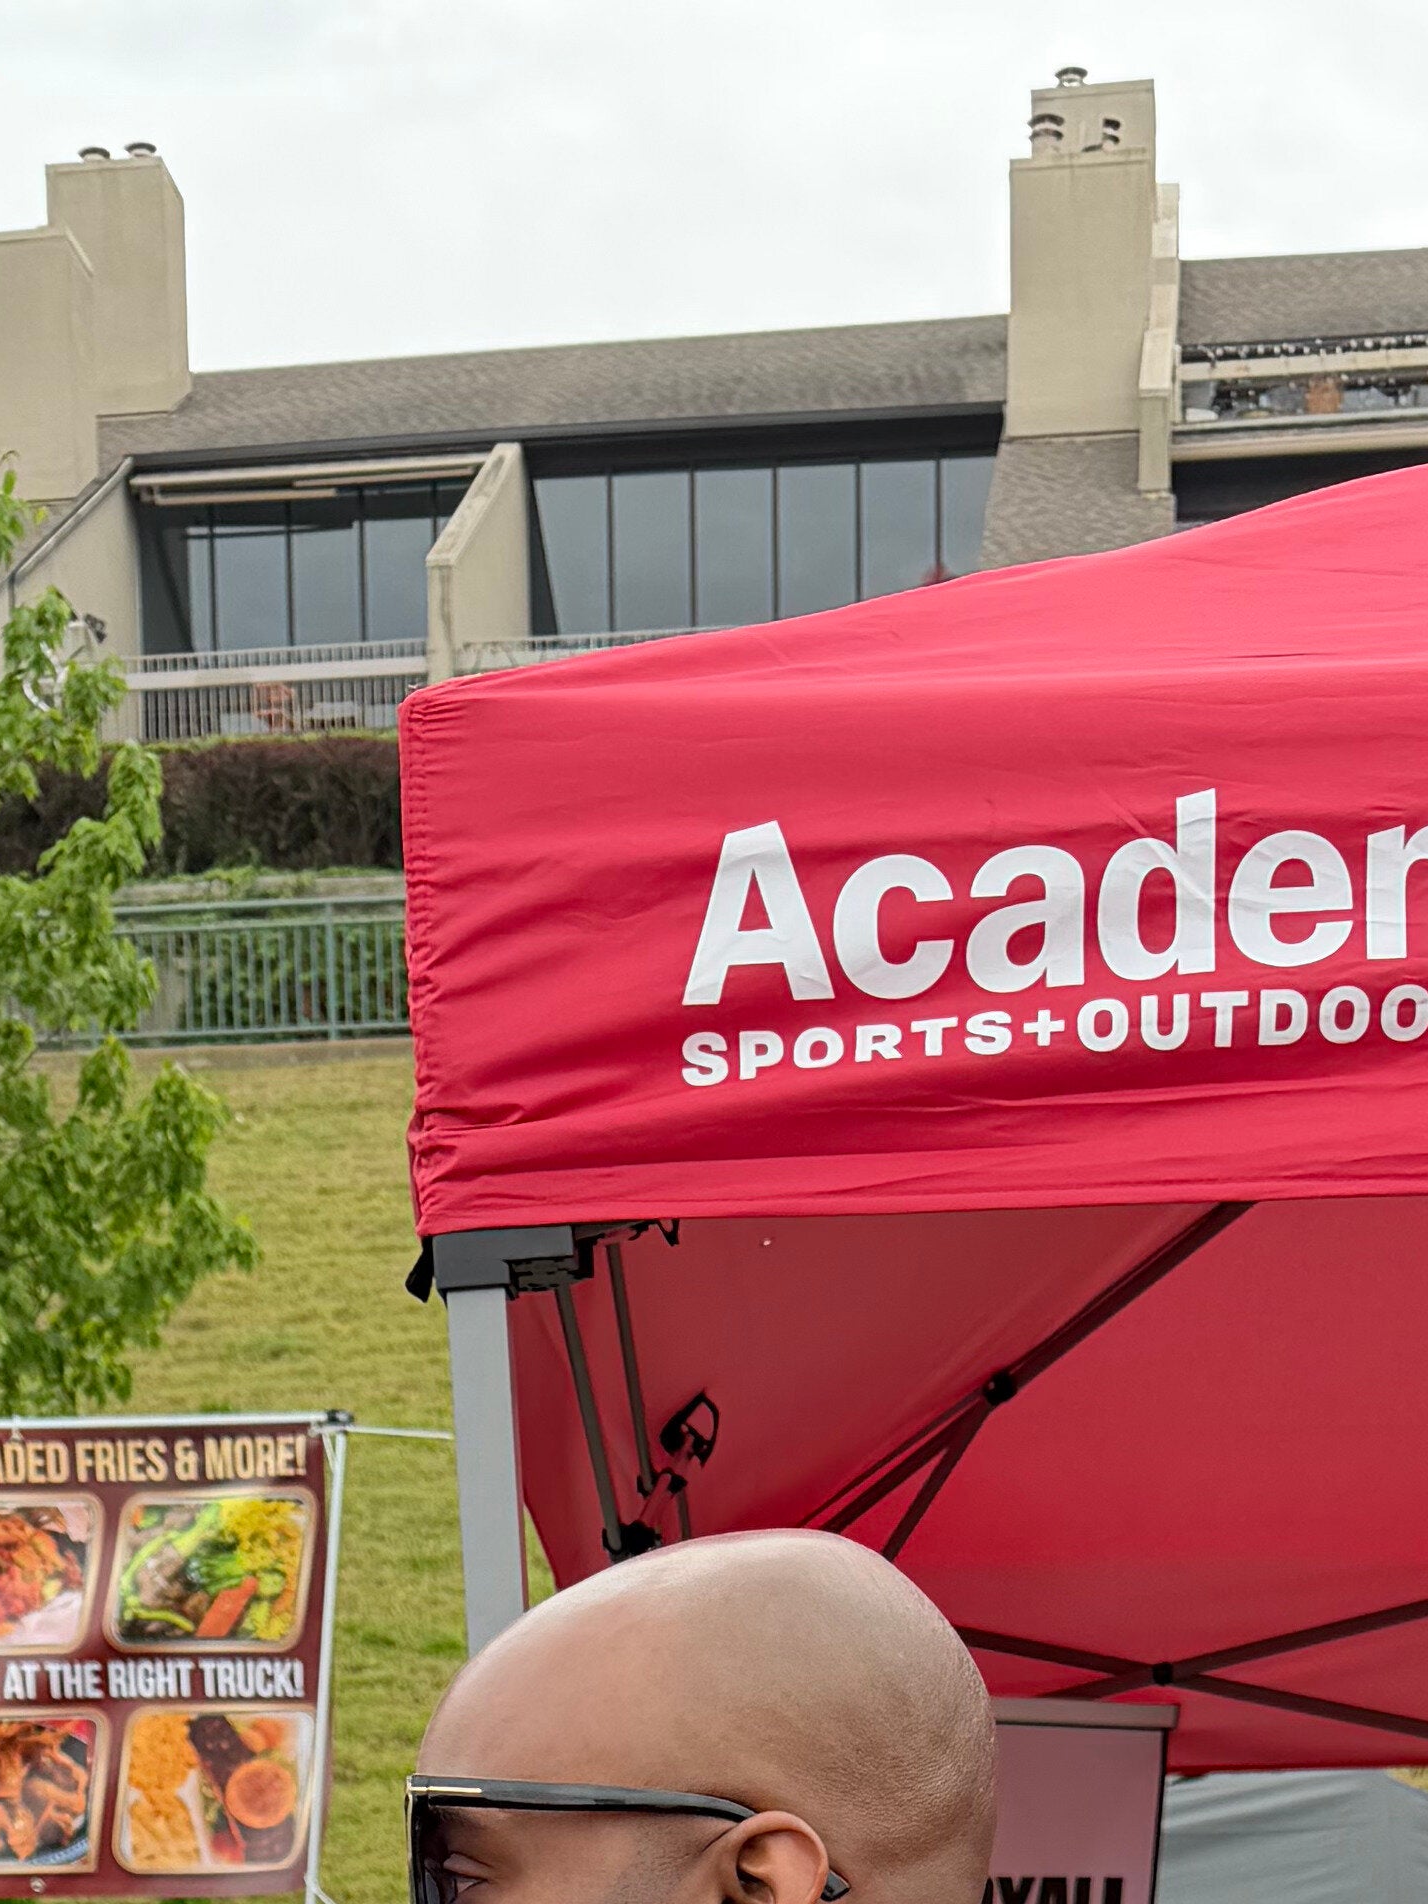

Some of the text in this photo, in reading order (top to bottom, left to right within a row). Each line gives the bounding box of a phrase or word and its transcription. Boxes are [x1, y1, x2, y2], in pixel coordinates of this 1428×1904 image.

[74, 1437, 169, 1483] FRIES
[173, 1436, 199, 1481] &
[202, 1433, 308, 1477] MORE!
[3, 1660, 42, 1701] AT
[43, 1659, 105, 1700] THE
[107, 1657, 197, 1699] RIGHT
[198, 1656, 306, 1698] TRUCK!
